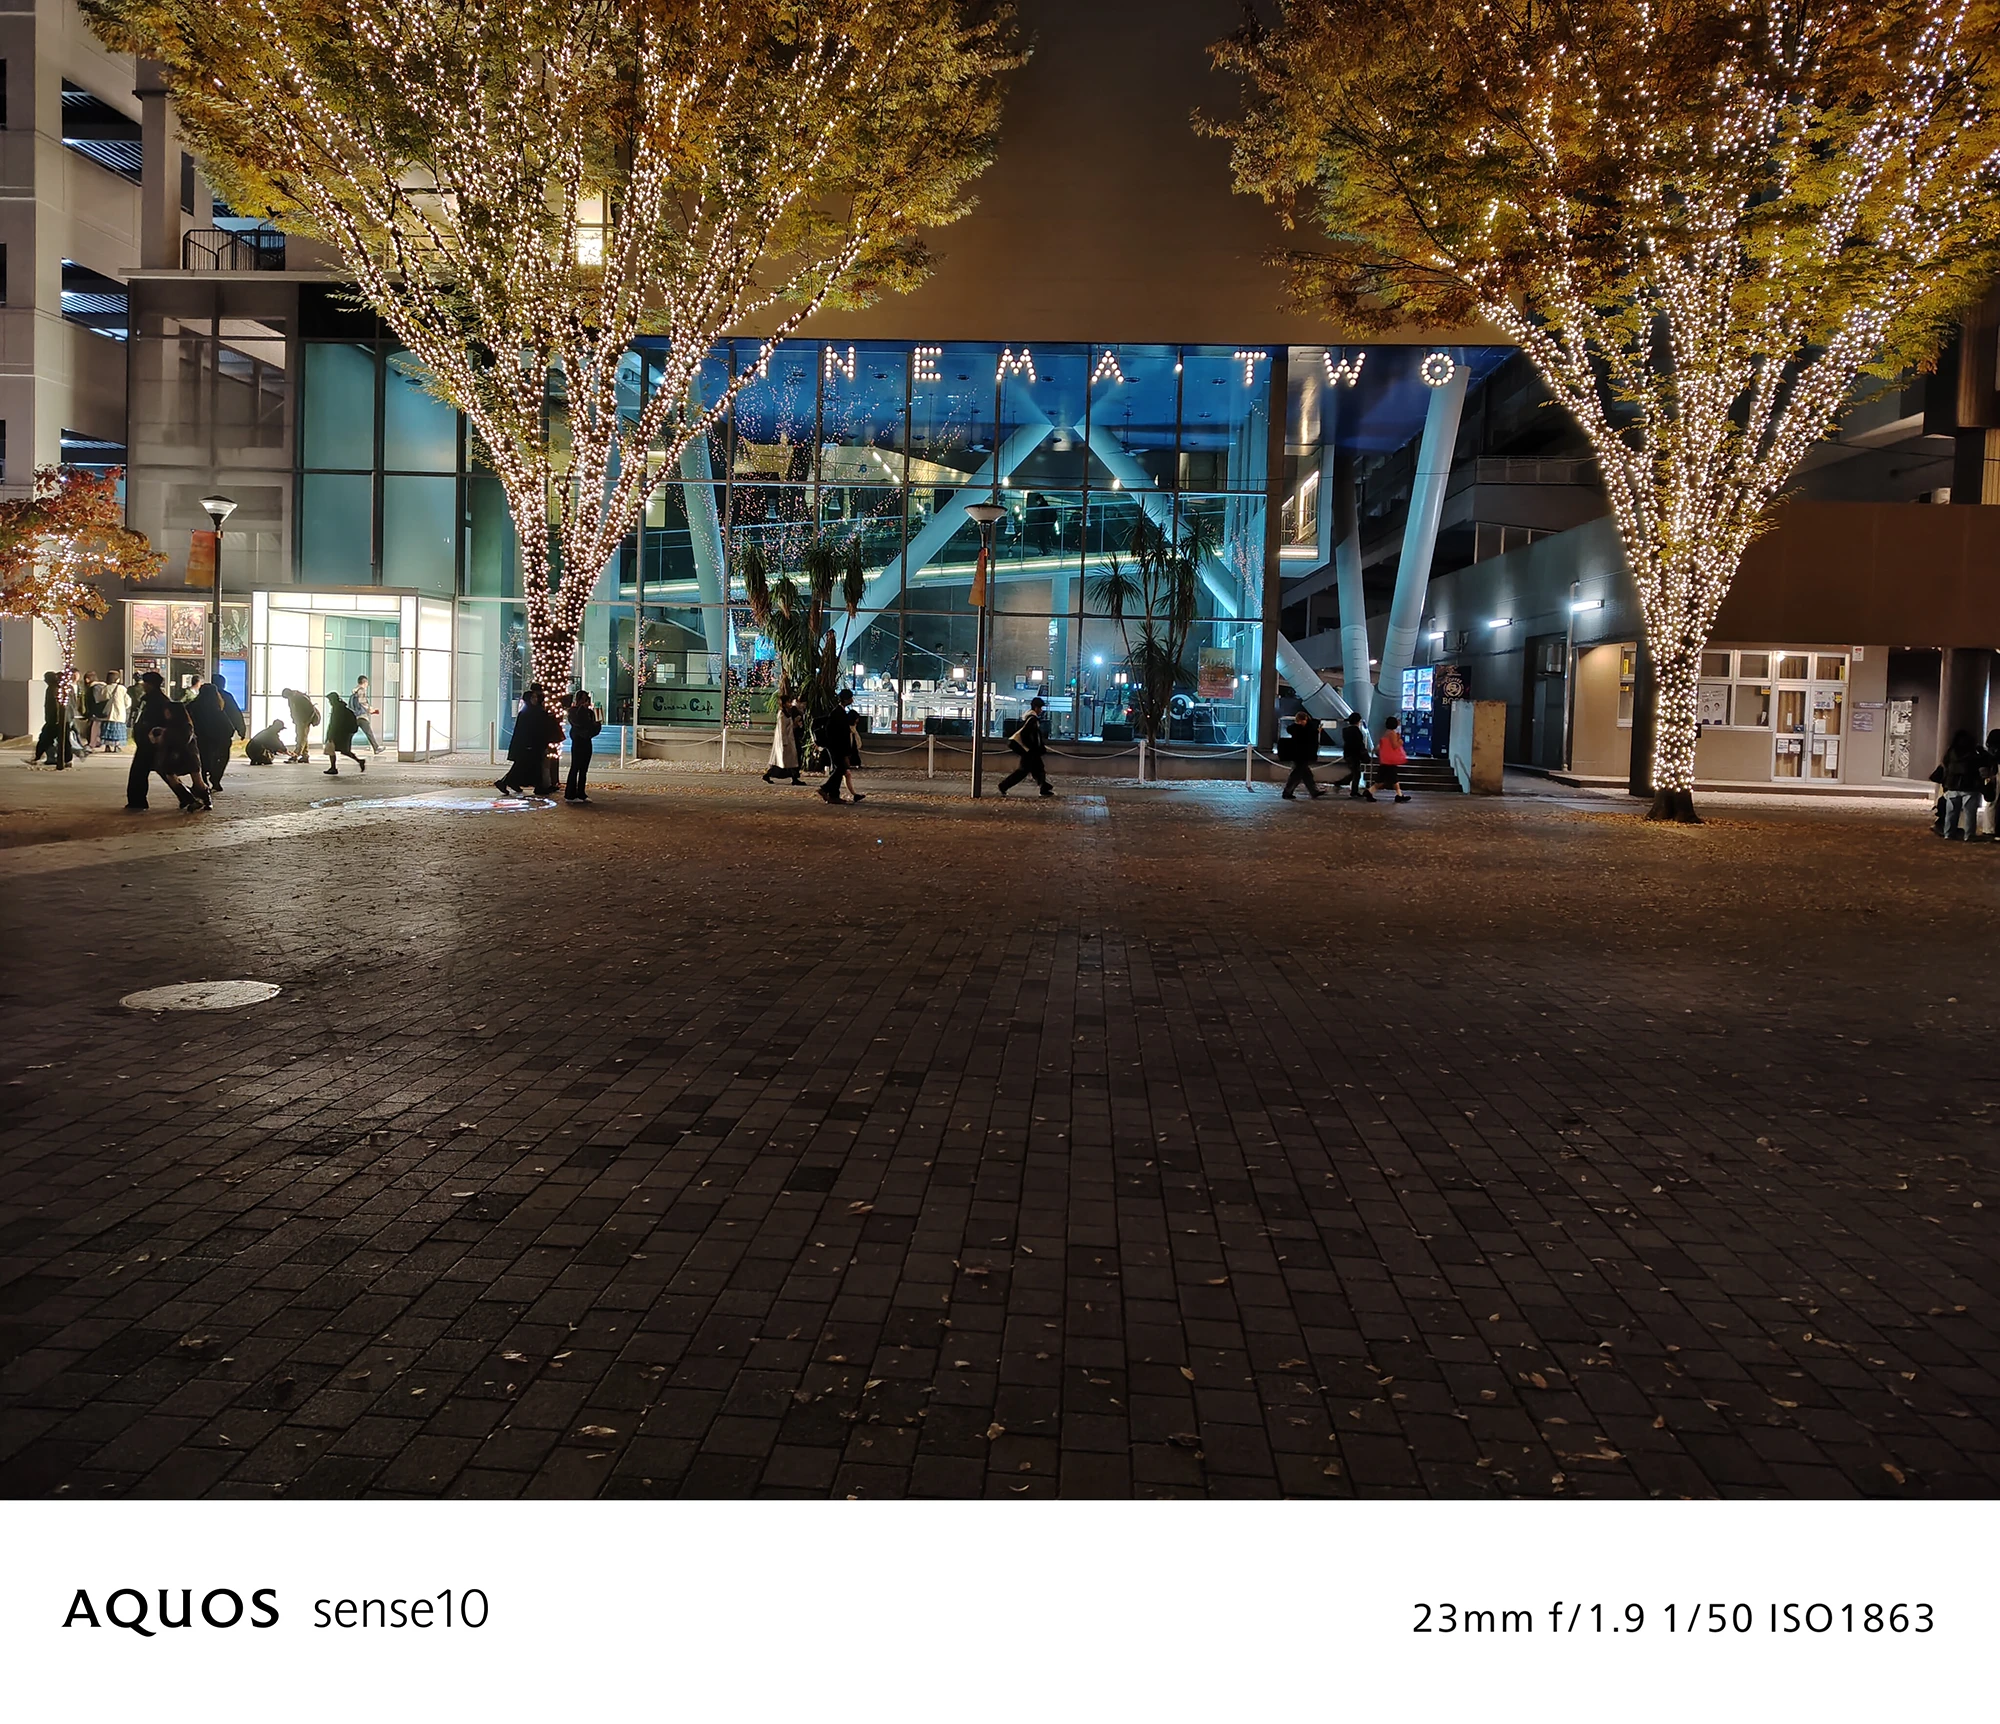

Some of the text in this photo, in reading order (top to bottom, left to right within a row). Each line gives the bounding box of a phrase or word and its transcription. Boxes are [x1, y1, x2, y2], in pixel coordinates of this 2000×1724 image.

[687, 343, 1455, 386] INEMA TWO
[1201, 657, 1232, 668] 2025
[653, 696, 687, 712] Cinema
